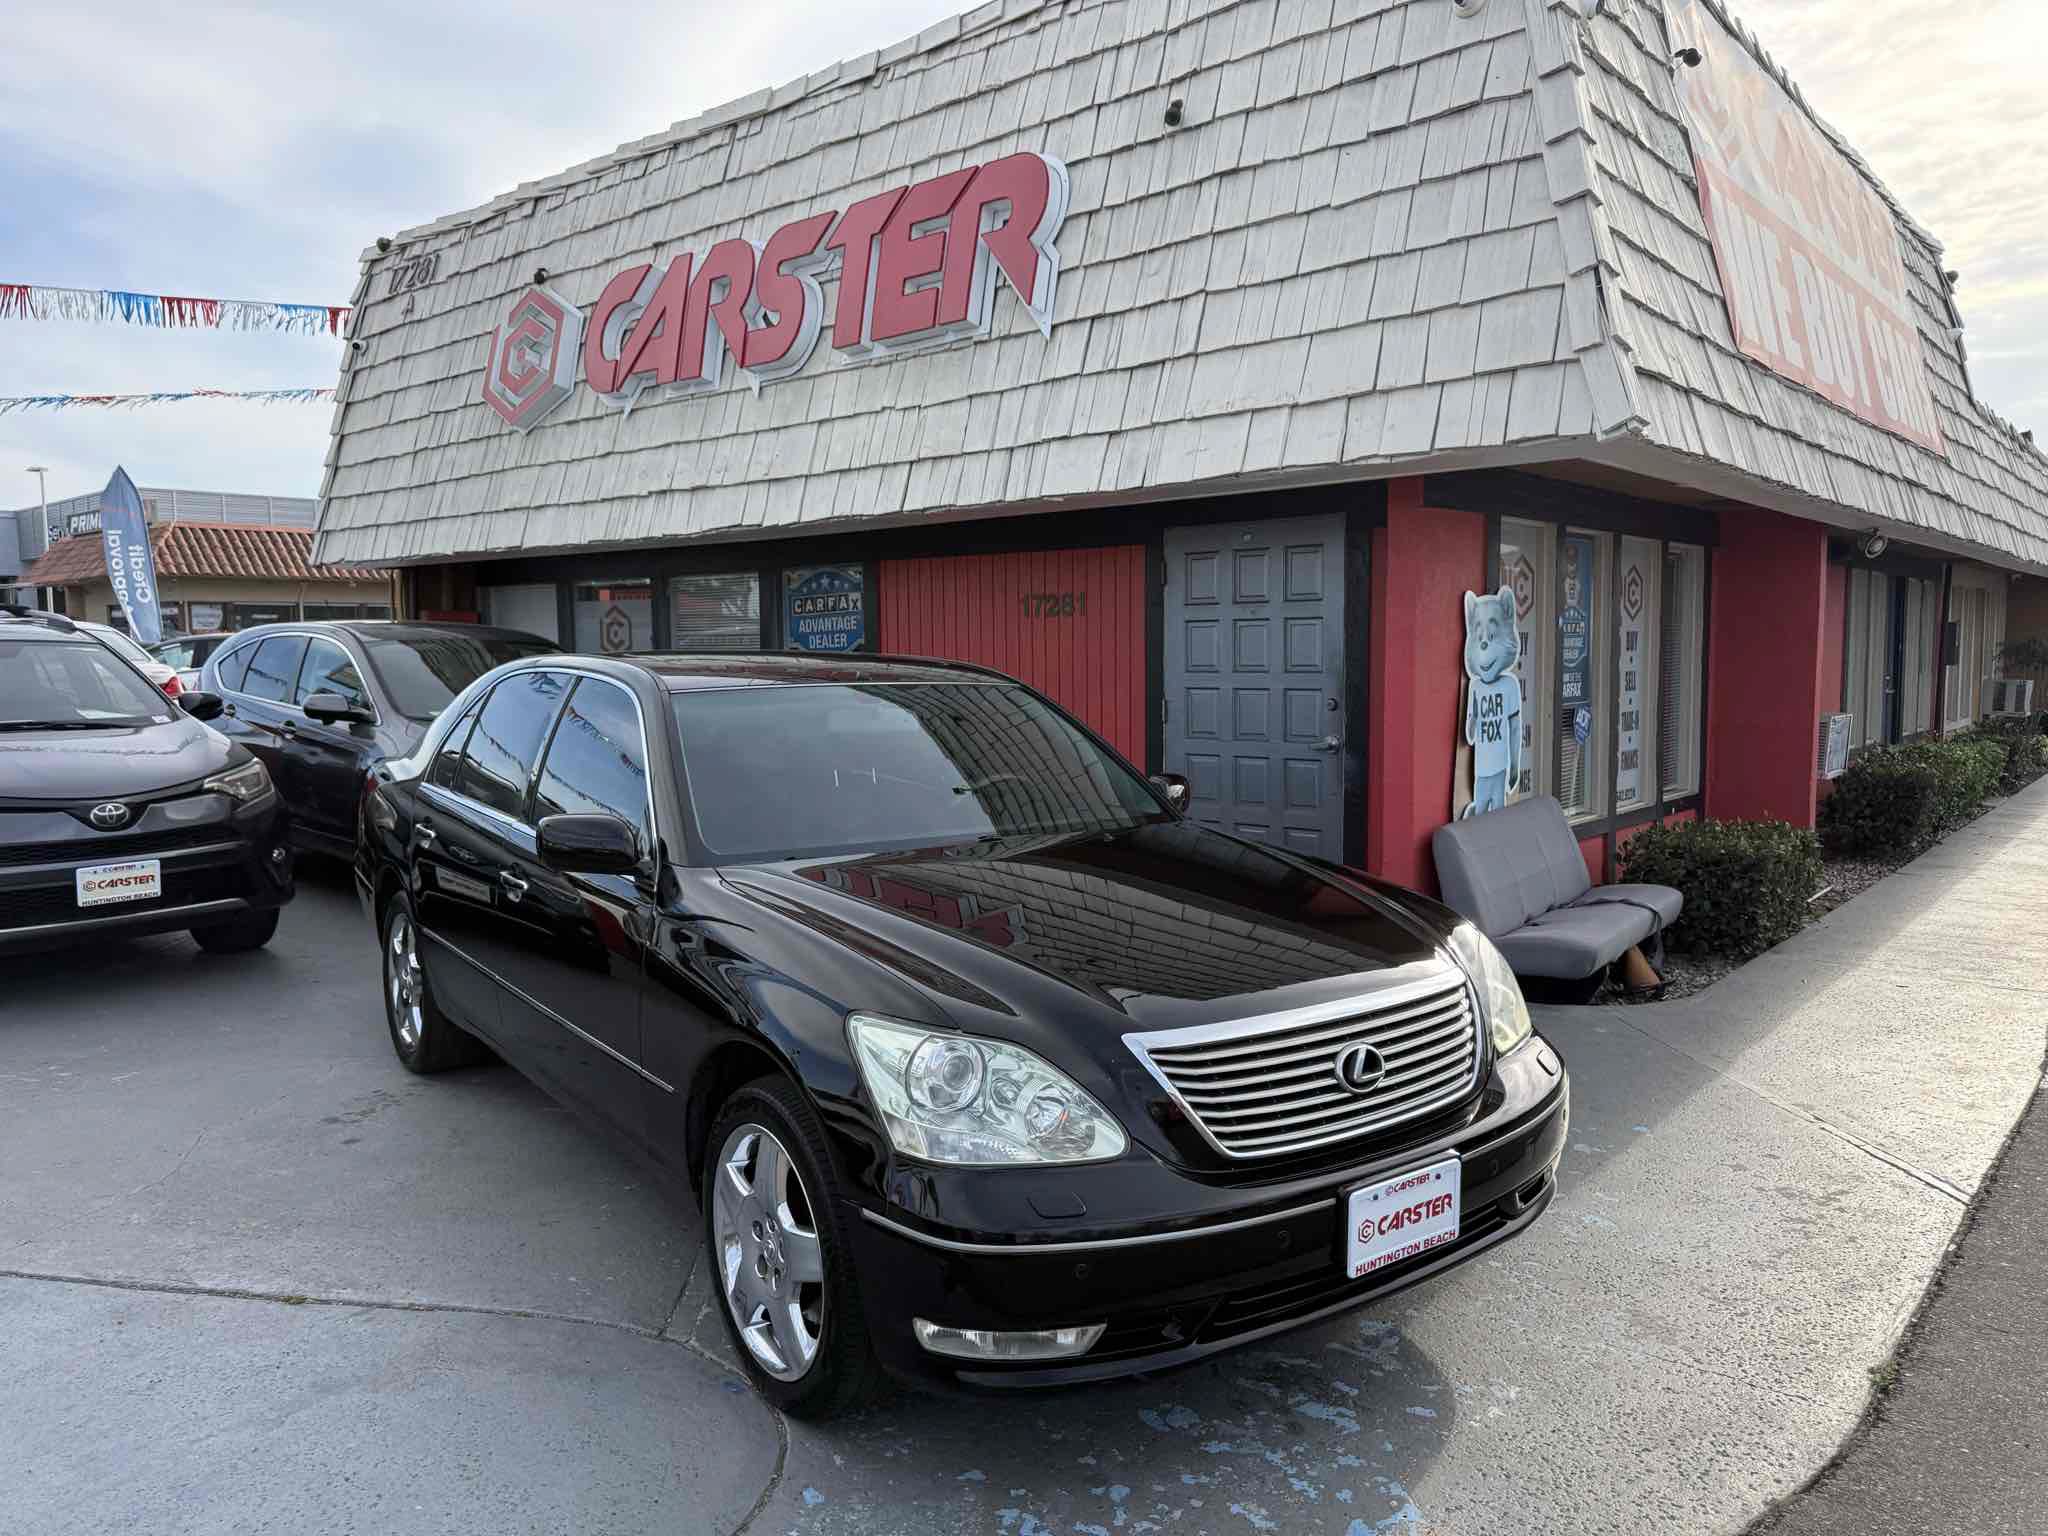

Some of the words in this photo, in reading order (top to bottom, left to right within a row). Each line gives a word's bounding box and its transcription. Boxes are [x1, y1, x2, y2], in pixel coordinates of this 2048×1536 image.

[389, 253, 440, 295] 17281
[583, 151, 1058, 396] CARSTER
[1787, 243, 1872, 409] BUY
[70, 510, 102, 533] PRIM
[794, 595, 862, 614] CARFAX
[799, 616, 858, 633] ADVANTAGE
[808, 633, 849, 649] DEALER
[1562, 682, 1583, 697] ARFAX
[1480, 693, 1504, 719] CAR
[1480, 718, 1503, 744] FOX
[97, 874, 155, 889] CARSTER
[1394, 1173, 1430, 1193] CARSTER
[1377, 1193, 1453, 1235] CARSTER
[1355, 1241, 1421, 1277] HUNTINGTON
[1423, 1229, 1456, 1249] BEACH
